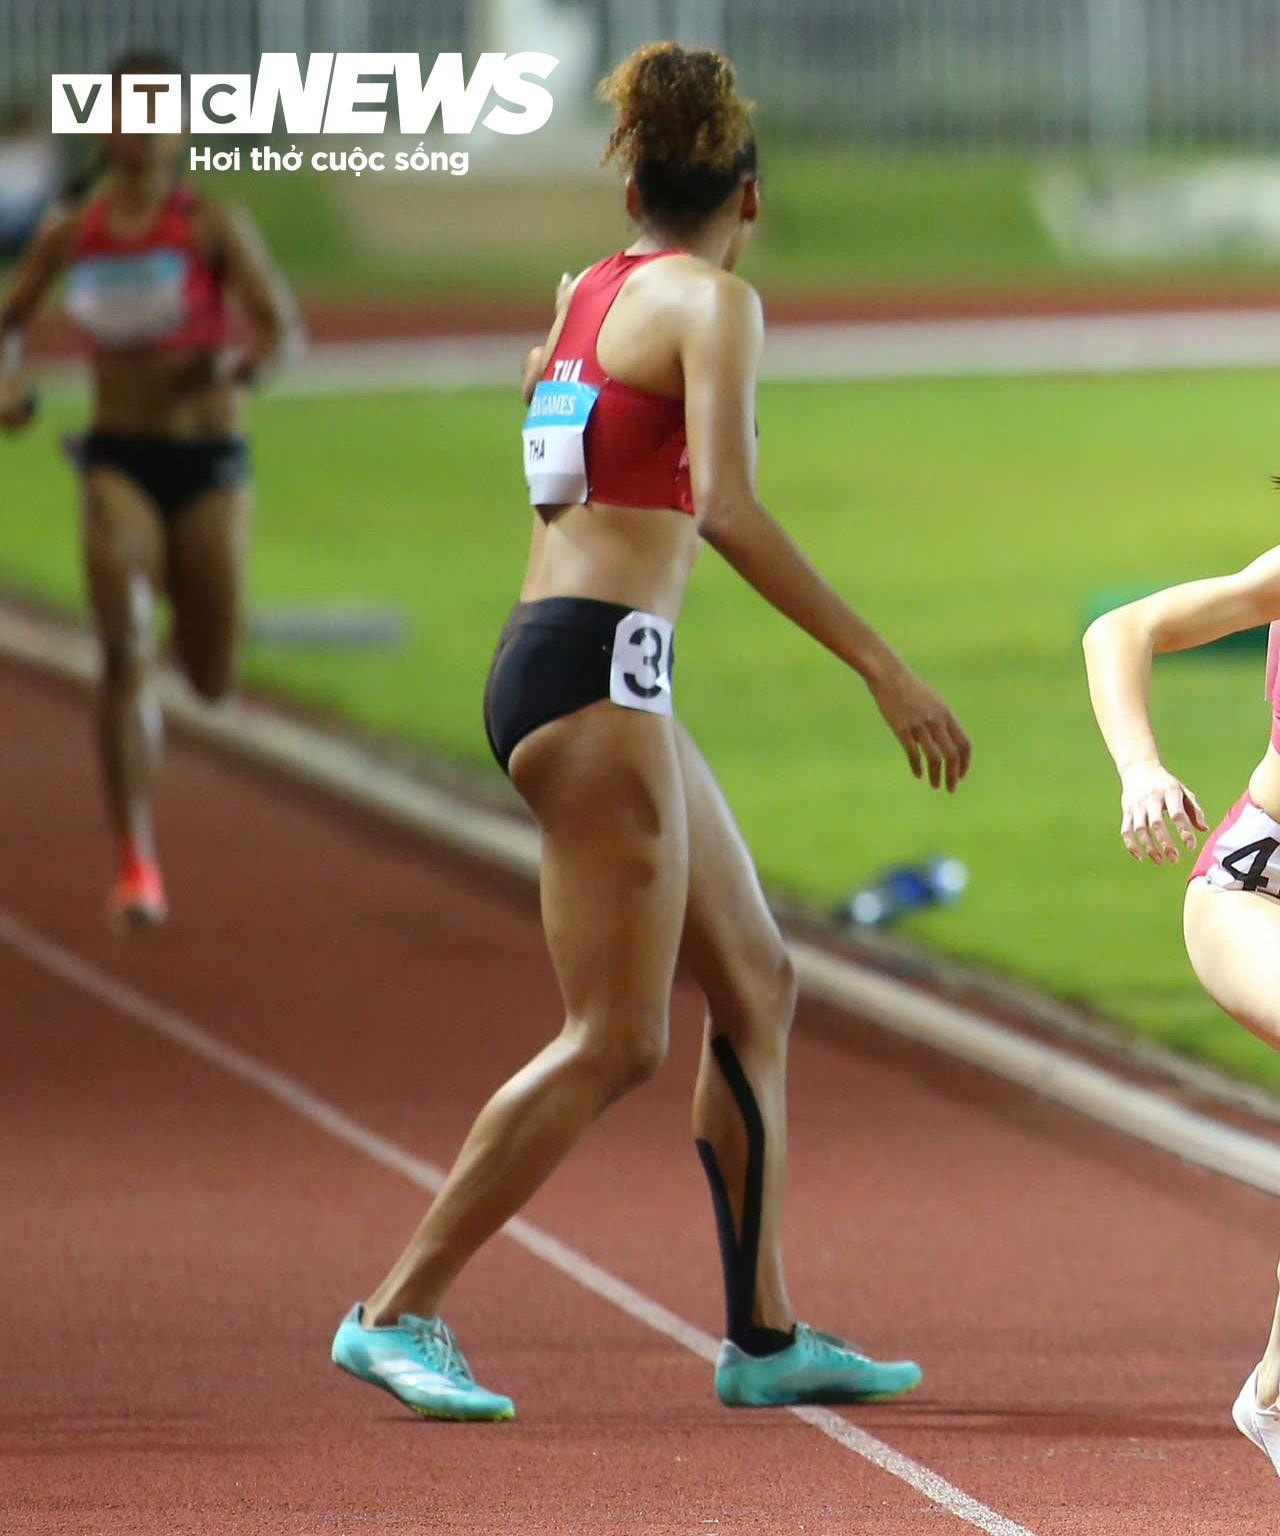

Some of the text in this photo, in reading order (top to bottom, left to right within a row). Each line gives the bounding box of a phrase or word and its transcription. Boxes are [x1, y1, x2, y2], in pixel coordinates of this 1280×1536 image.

[529, 439, 546, 462] THA
[623, 627, 662, 699] 3
[1222, 836, 1280, 891] 4
